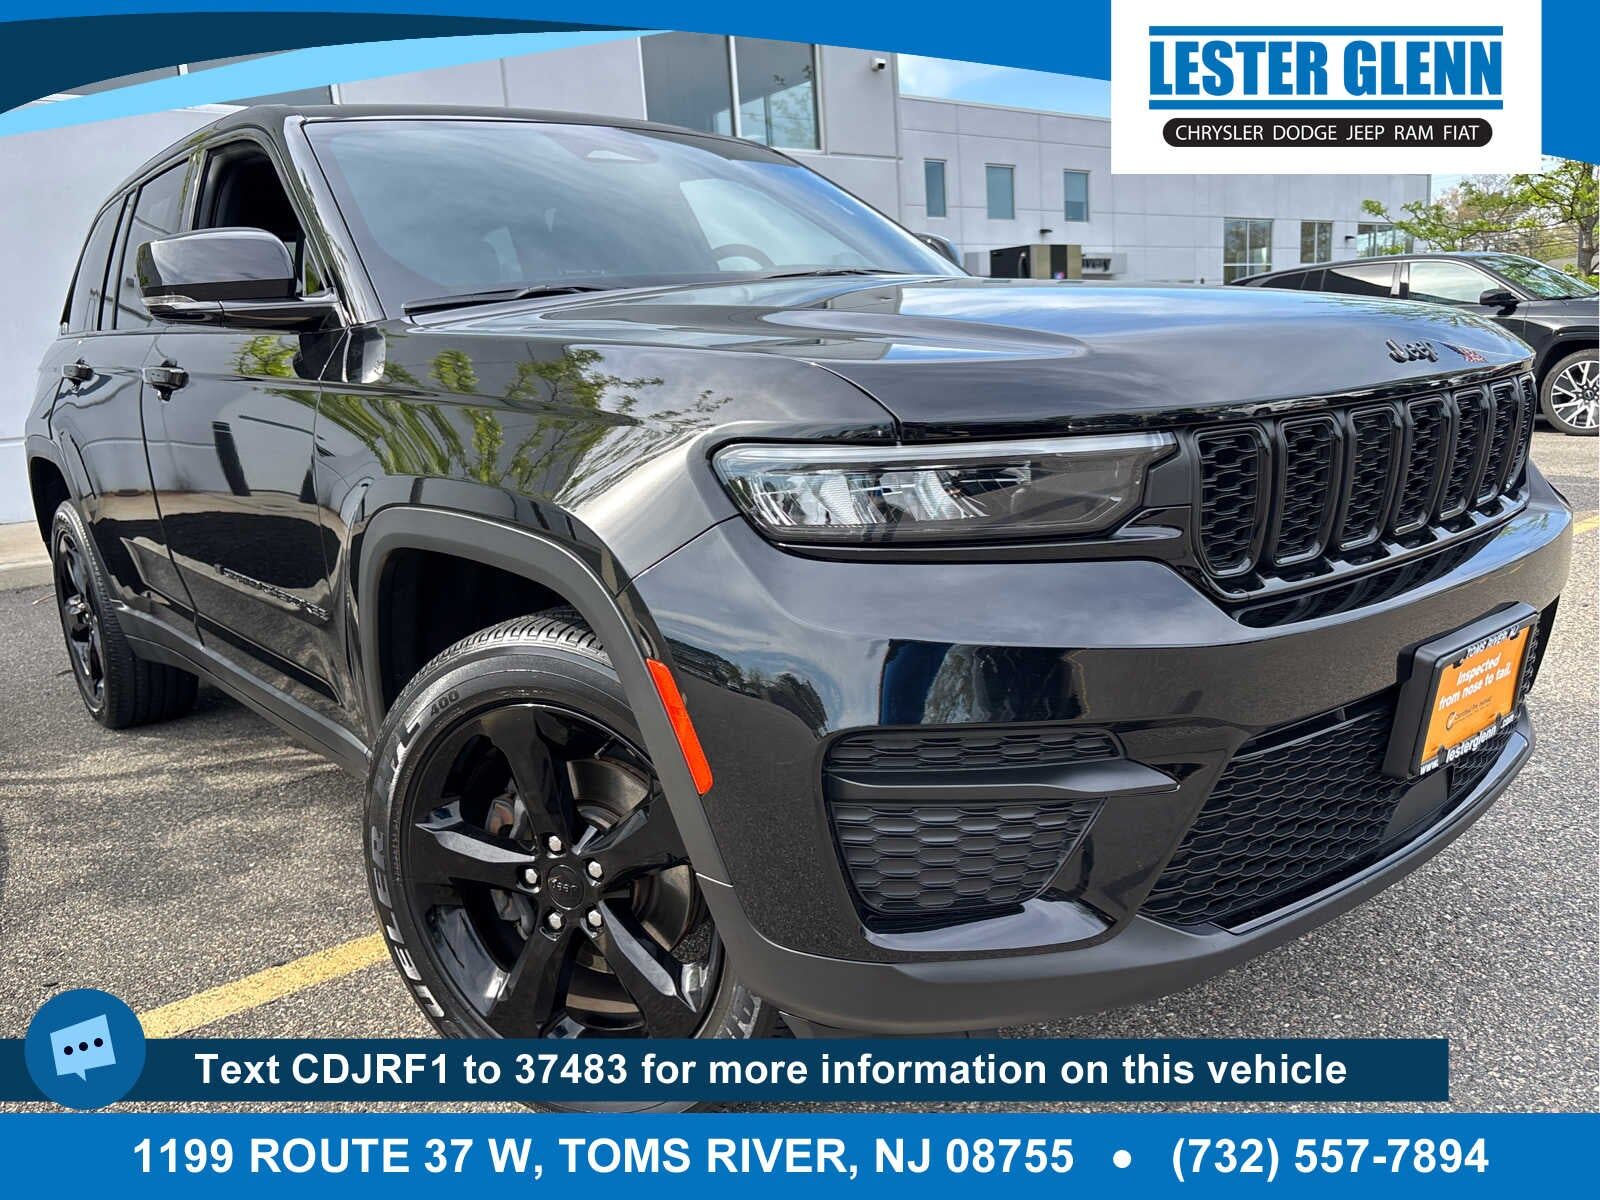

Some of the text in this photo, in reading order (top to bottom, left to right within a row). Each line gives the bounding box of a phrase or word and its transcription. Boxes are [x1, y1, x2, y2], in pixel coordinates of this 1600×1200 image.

[1385, 338, 1439, 364] Jeep
[1456, 652, 1502, 686] Inspected
[430, 688, 461, 717] 400
[1438, 690, 1462, 711] from
[1462, 679, 1484, 698] nose
[1484, 674, 1495, 687] to
[1446, 726, 1497, 763] lesterglenn
